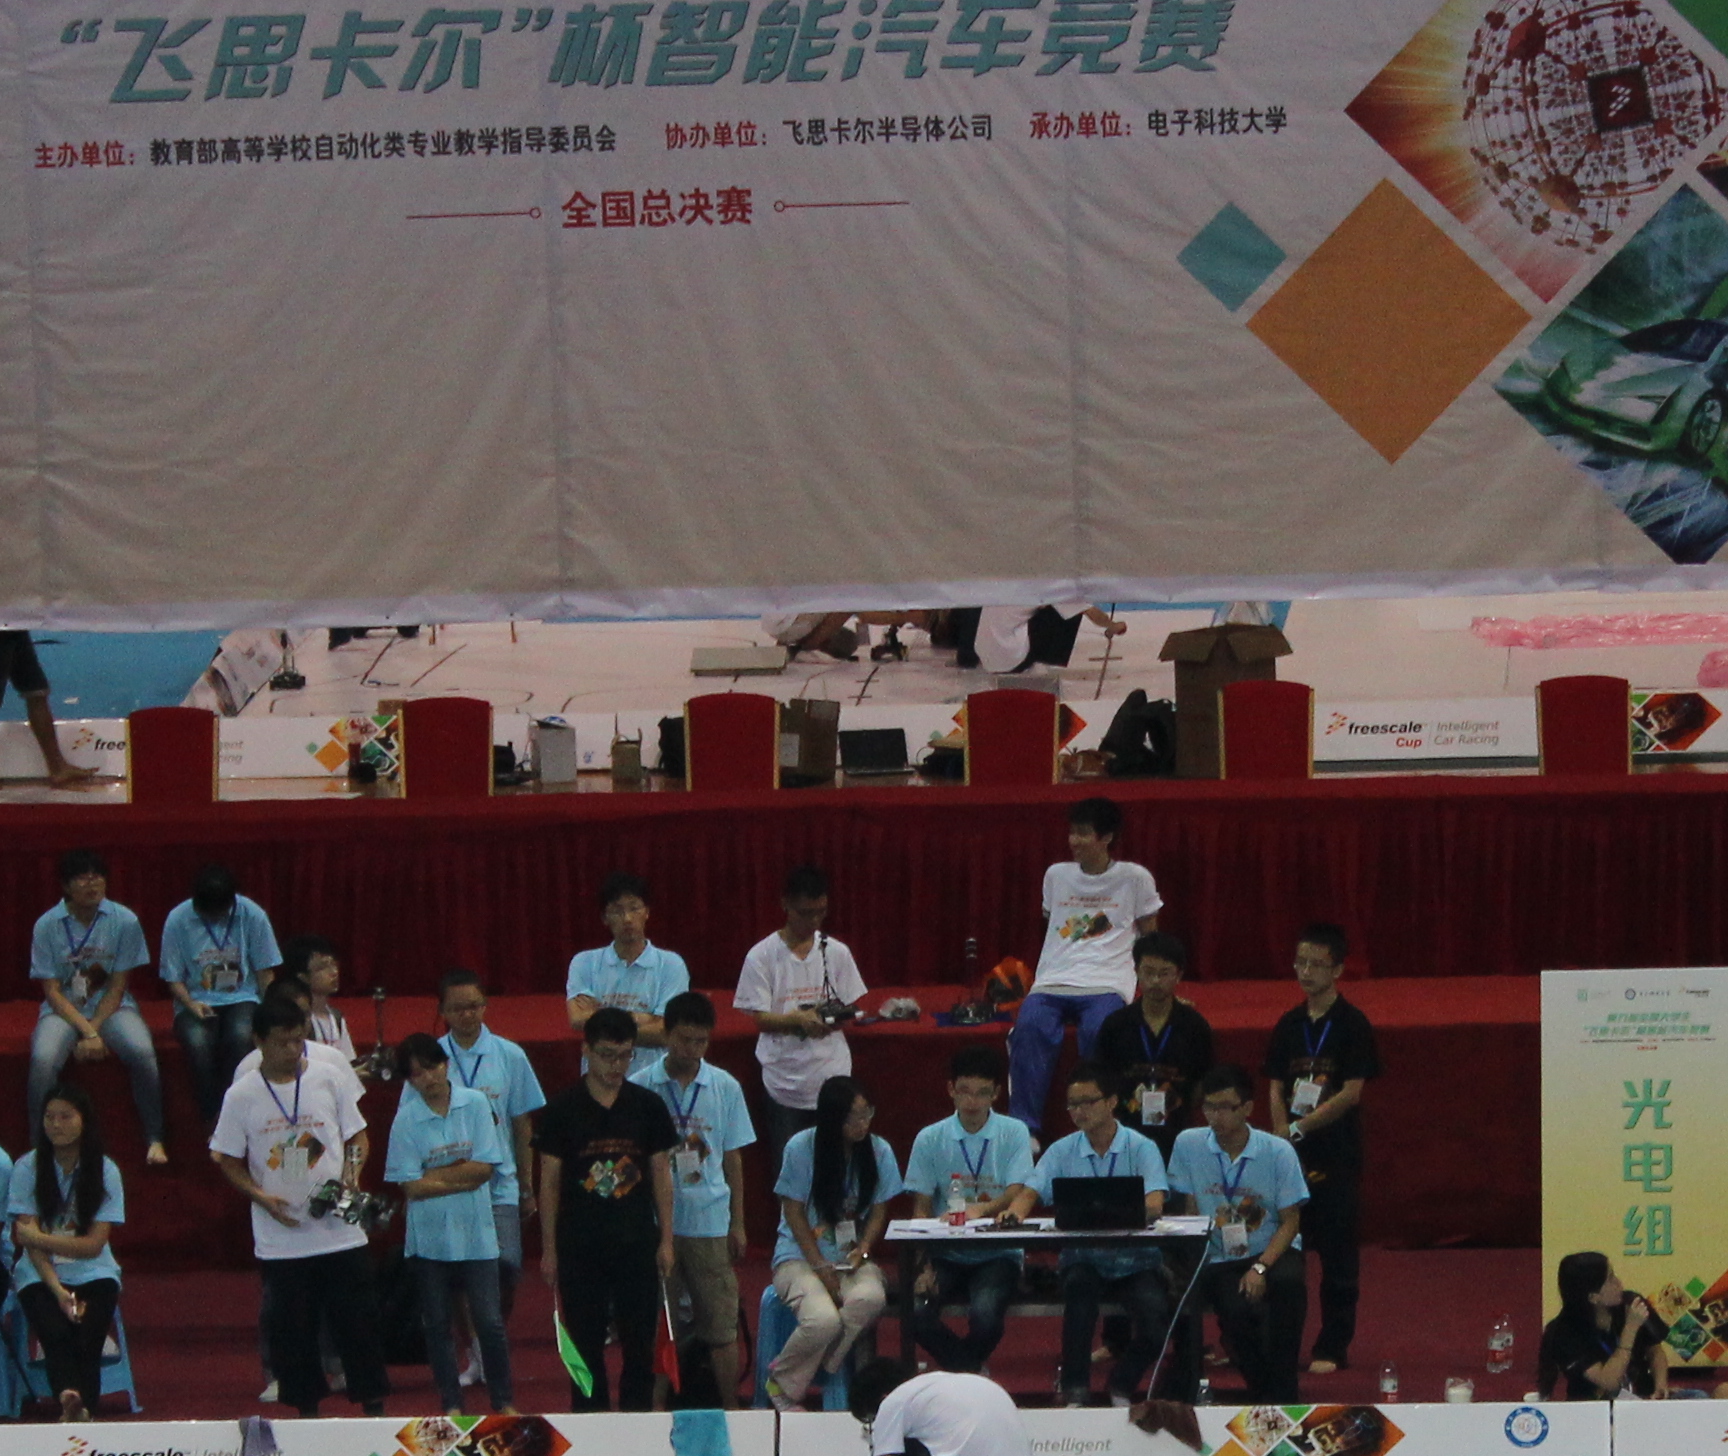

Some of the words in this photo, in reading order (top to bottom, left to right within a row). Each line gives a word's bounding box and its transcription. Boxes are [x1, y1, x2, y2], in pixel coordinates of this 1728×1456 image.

[562, 186, 753, 230] 全国总决赛
[1349, 720, 1422, 737] freescale
[1396, 736, 1422, 750] Cup
[1434, 734, 1457, 746] Car
[1459, 733, 1500, 747] Racing
[1622, 1078, 1673, 1256] 光电组
